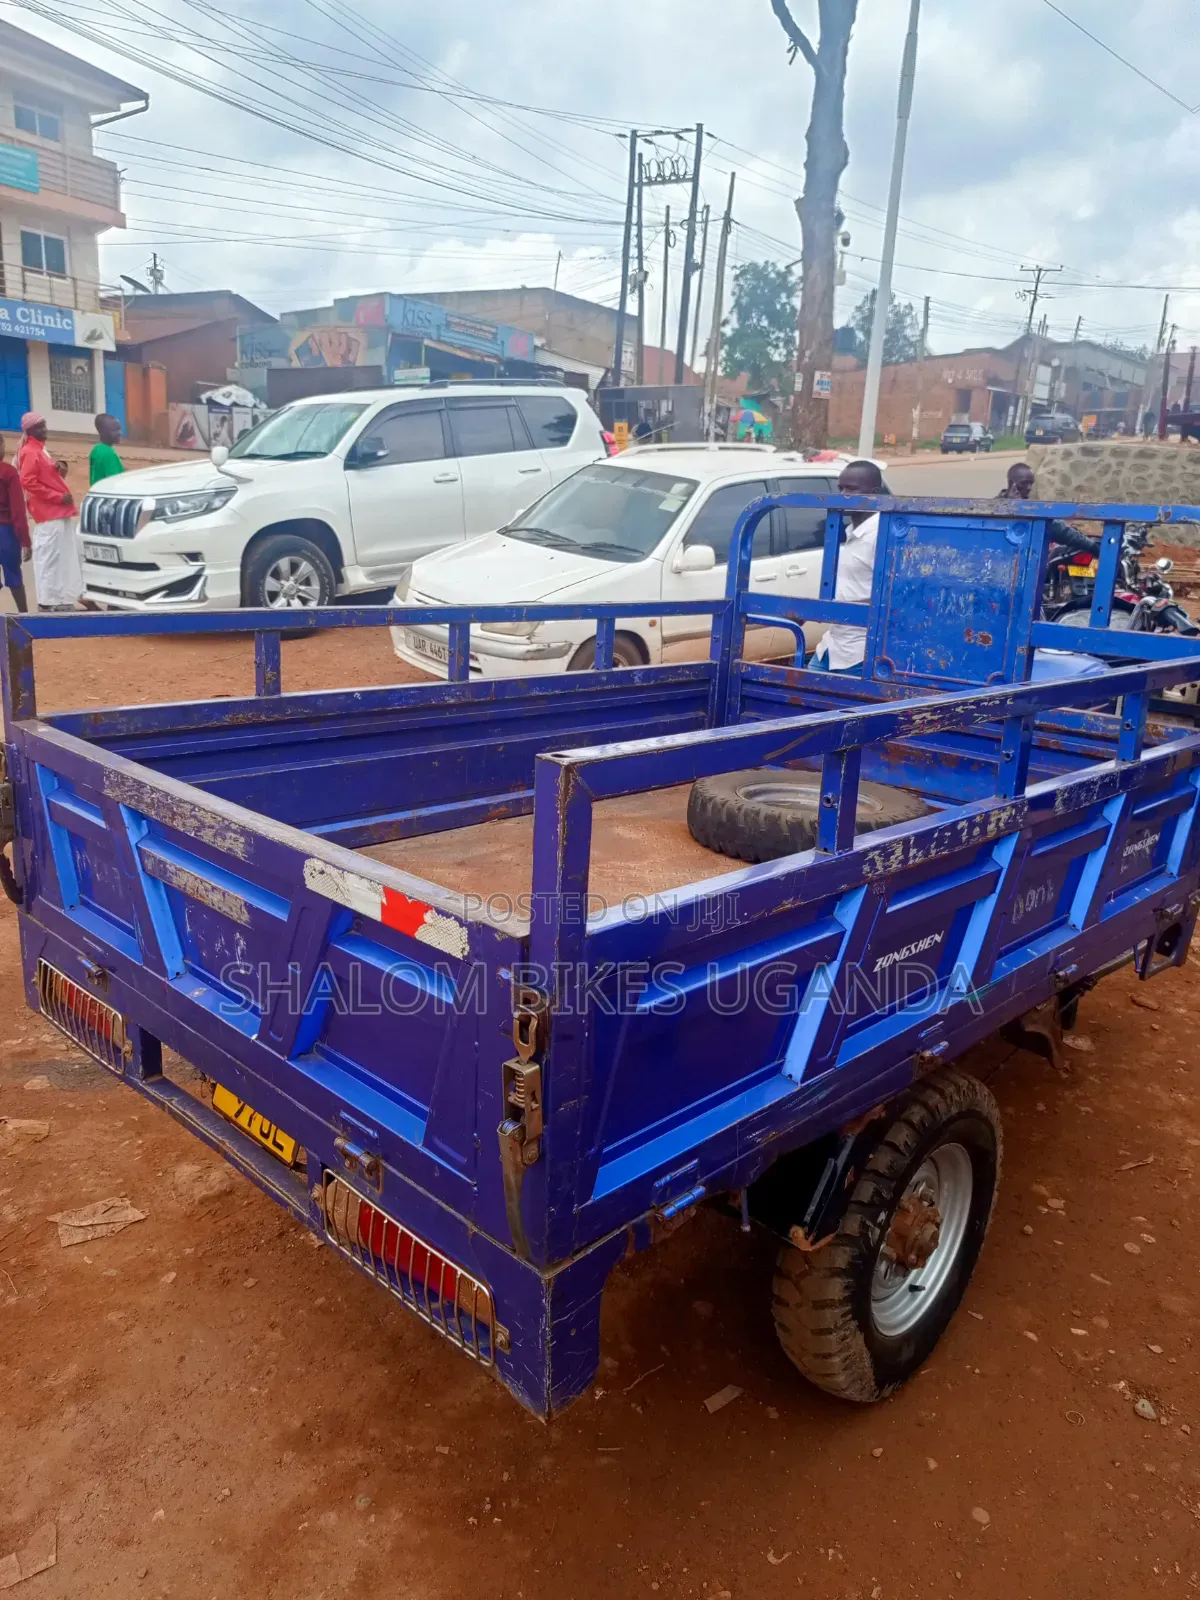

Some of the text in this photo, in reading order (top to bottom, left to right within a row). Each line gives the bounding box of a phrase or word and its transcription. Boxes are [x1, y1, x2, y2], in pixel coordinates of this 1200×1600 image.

[16, 307, 73, 330] Clinic
[14, 324, 46, 337] 421754
[413, 635, 427, 652] UAR
[872, 930, 945, 973] ZONGSHEN
